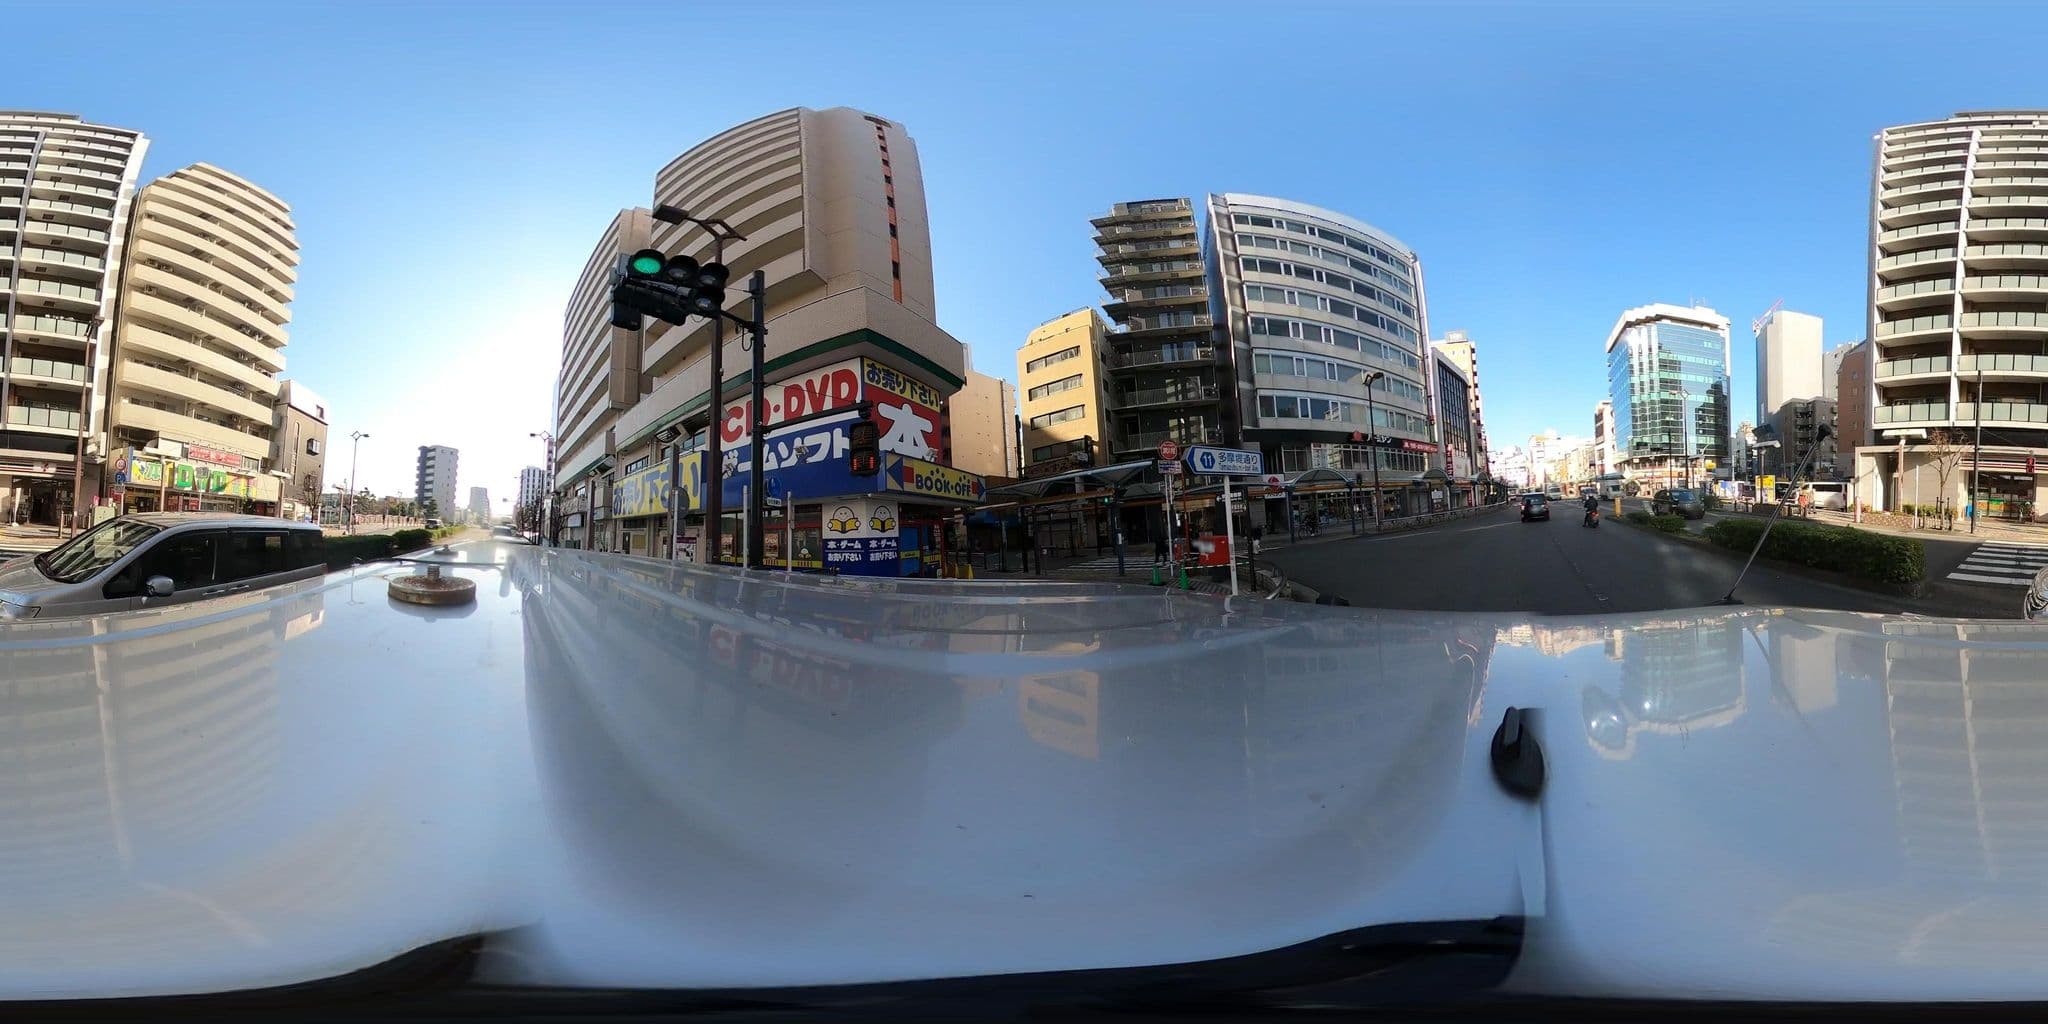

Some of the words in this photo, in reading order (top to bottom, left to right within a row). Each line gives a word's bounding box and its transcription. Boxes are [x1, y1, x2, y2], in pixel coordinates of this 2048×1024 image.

[866, 362, 939, 408] お売り下さい
[878, 403, 933, 463] 本
